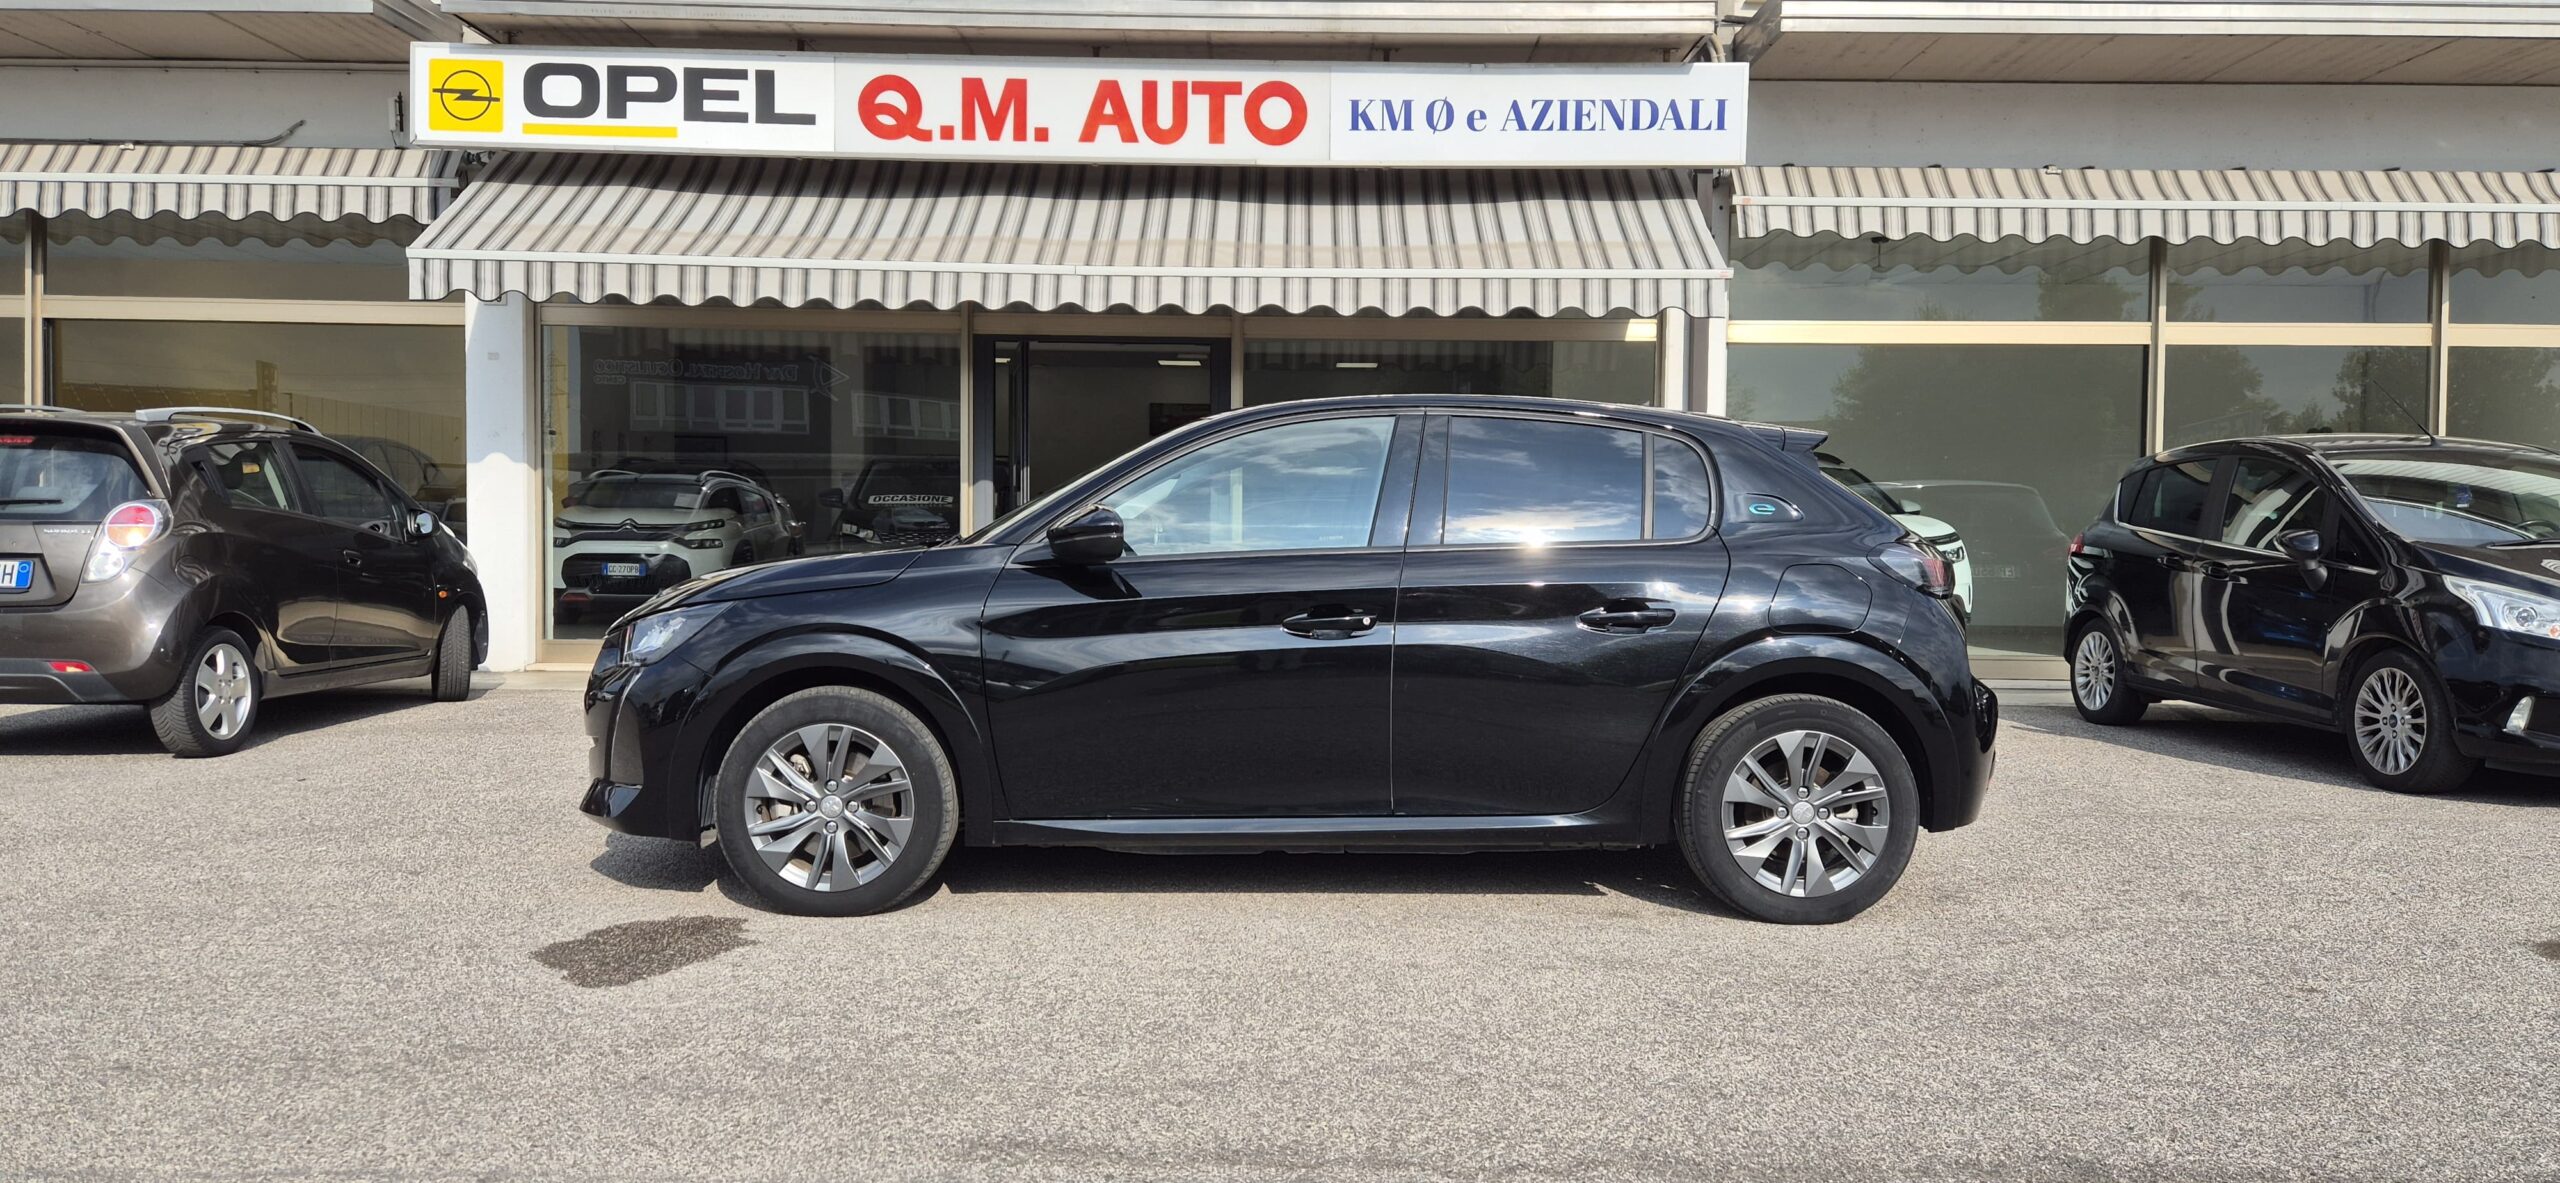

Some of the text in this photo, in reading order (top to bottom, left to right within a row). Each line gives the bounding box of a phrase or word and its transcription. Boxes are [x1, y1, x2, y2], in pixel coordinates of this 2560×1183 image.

[523, 62, 816, 126] OPEL
[857, 74, 1309, 146] Q.M. AUTO
[1349, 98, 1414, 132] KM
[1466, 110, 1488, 132] e
[1500, 98, 1728, 133] AZIENDALI
[872, 495, 950, 503] OCCASIONE
[0, 563, 16, 585] H
